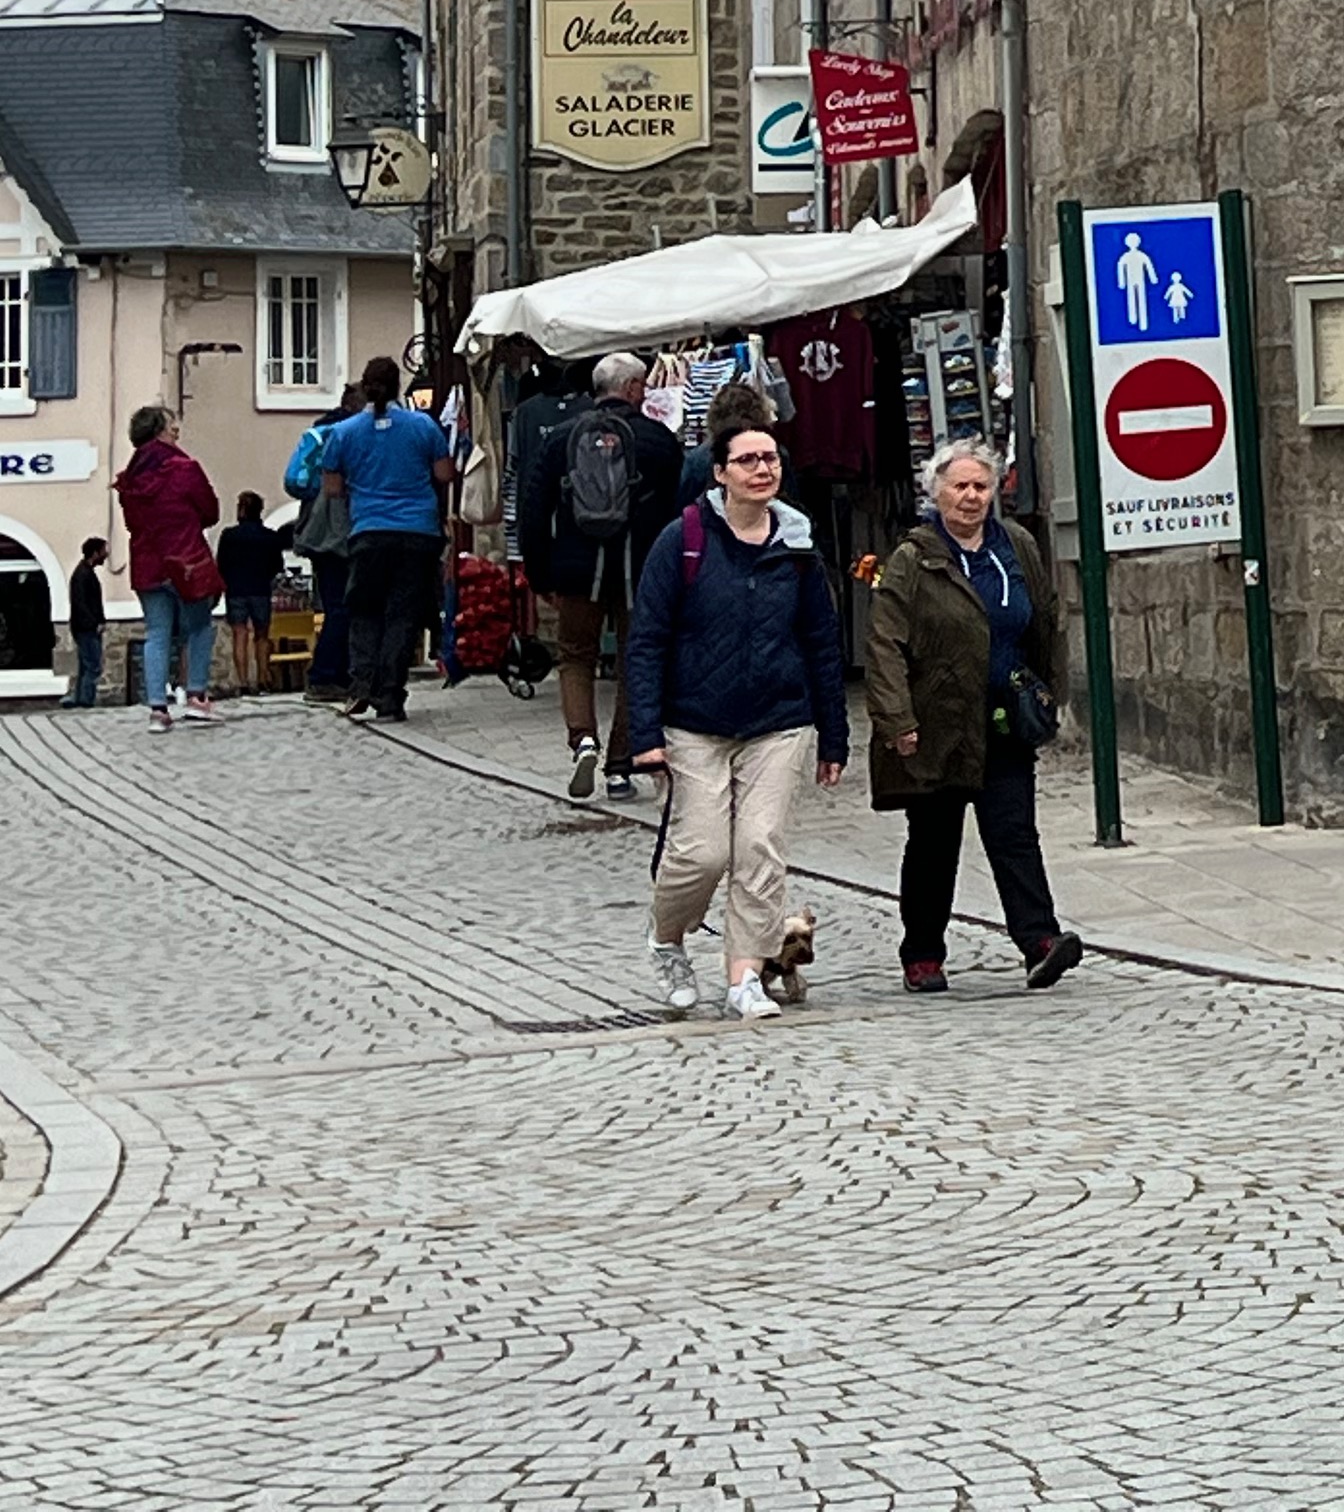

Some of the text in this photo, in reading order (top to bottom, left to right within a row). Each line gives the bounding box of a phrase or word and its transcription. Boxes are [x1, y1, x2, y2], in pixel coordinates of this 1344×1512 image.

[611, 1, 633, 25] la
[563, 16, 689, 52] Chandeleur
[555, 94, 694, 113] SALADERIE
[568, 119, 676, 137] GLACIER
[1106, 491, 1235, 515] SAUF LIVRAISONS
[1113, 510, 1231, 535] ET SÉCURITÉ
